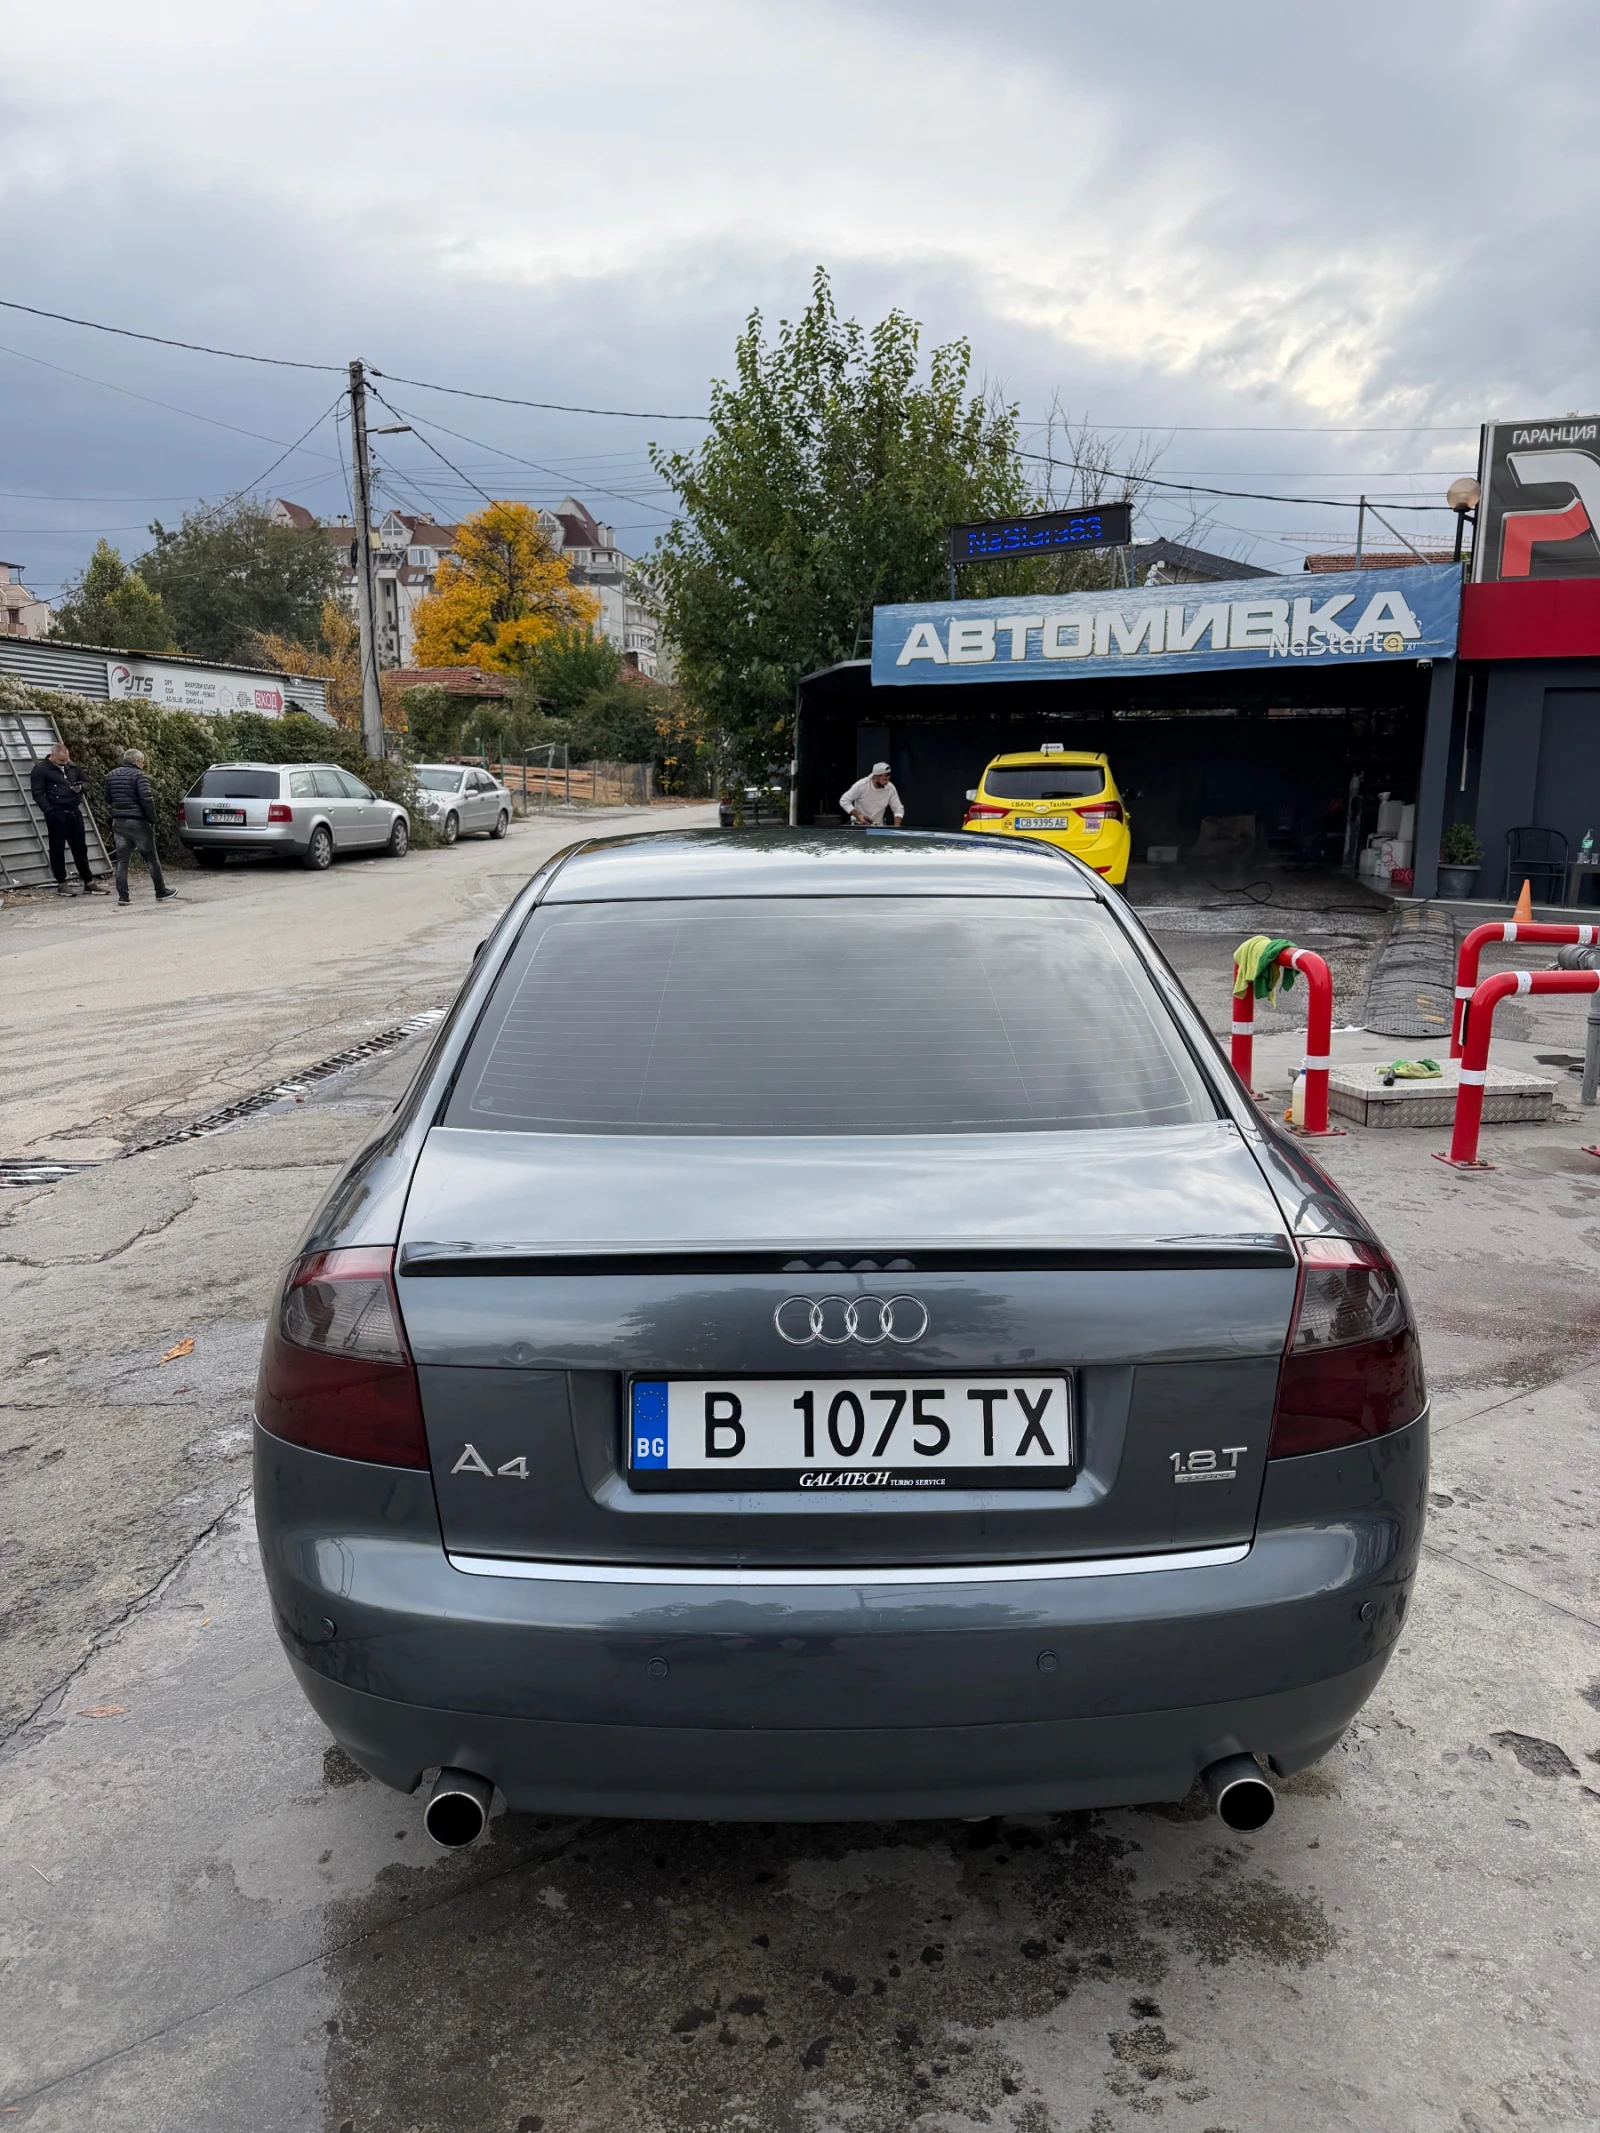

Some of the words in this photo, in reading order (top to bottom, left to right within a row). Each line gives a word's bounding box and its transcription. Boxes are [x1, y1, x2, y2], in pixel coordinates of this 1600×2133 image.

[1512, 424, 1597, 445] ГАРАНЦИЯ
[895, 590, 1423, 666] АВТОМИВКА
[1268, 630, 1404, 658] NaStarta
[124, 675, 154, 692] JTS
[255, 691, 277, 710] ВХОД
[1020, 818, 1032, 828] CB
[1033, 818, 1054, 828] 9395
[1054, 818, 1066, 828] AE
[704, 1391, 746, 1458] B
[792, 1389, 951, 1458] 1075
[966, 1388, 1056, 1457] TX
[636, 1436, 665, 1458] BG
[450, 1443, 530, 1480] A4
[799, 1471, 892, 1487] GALATECH
[890, 1478, 914, 1486] TURBO
[915, 1478, 946, 1486] SERVICE
